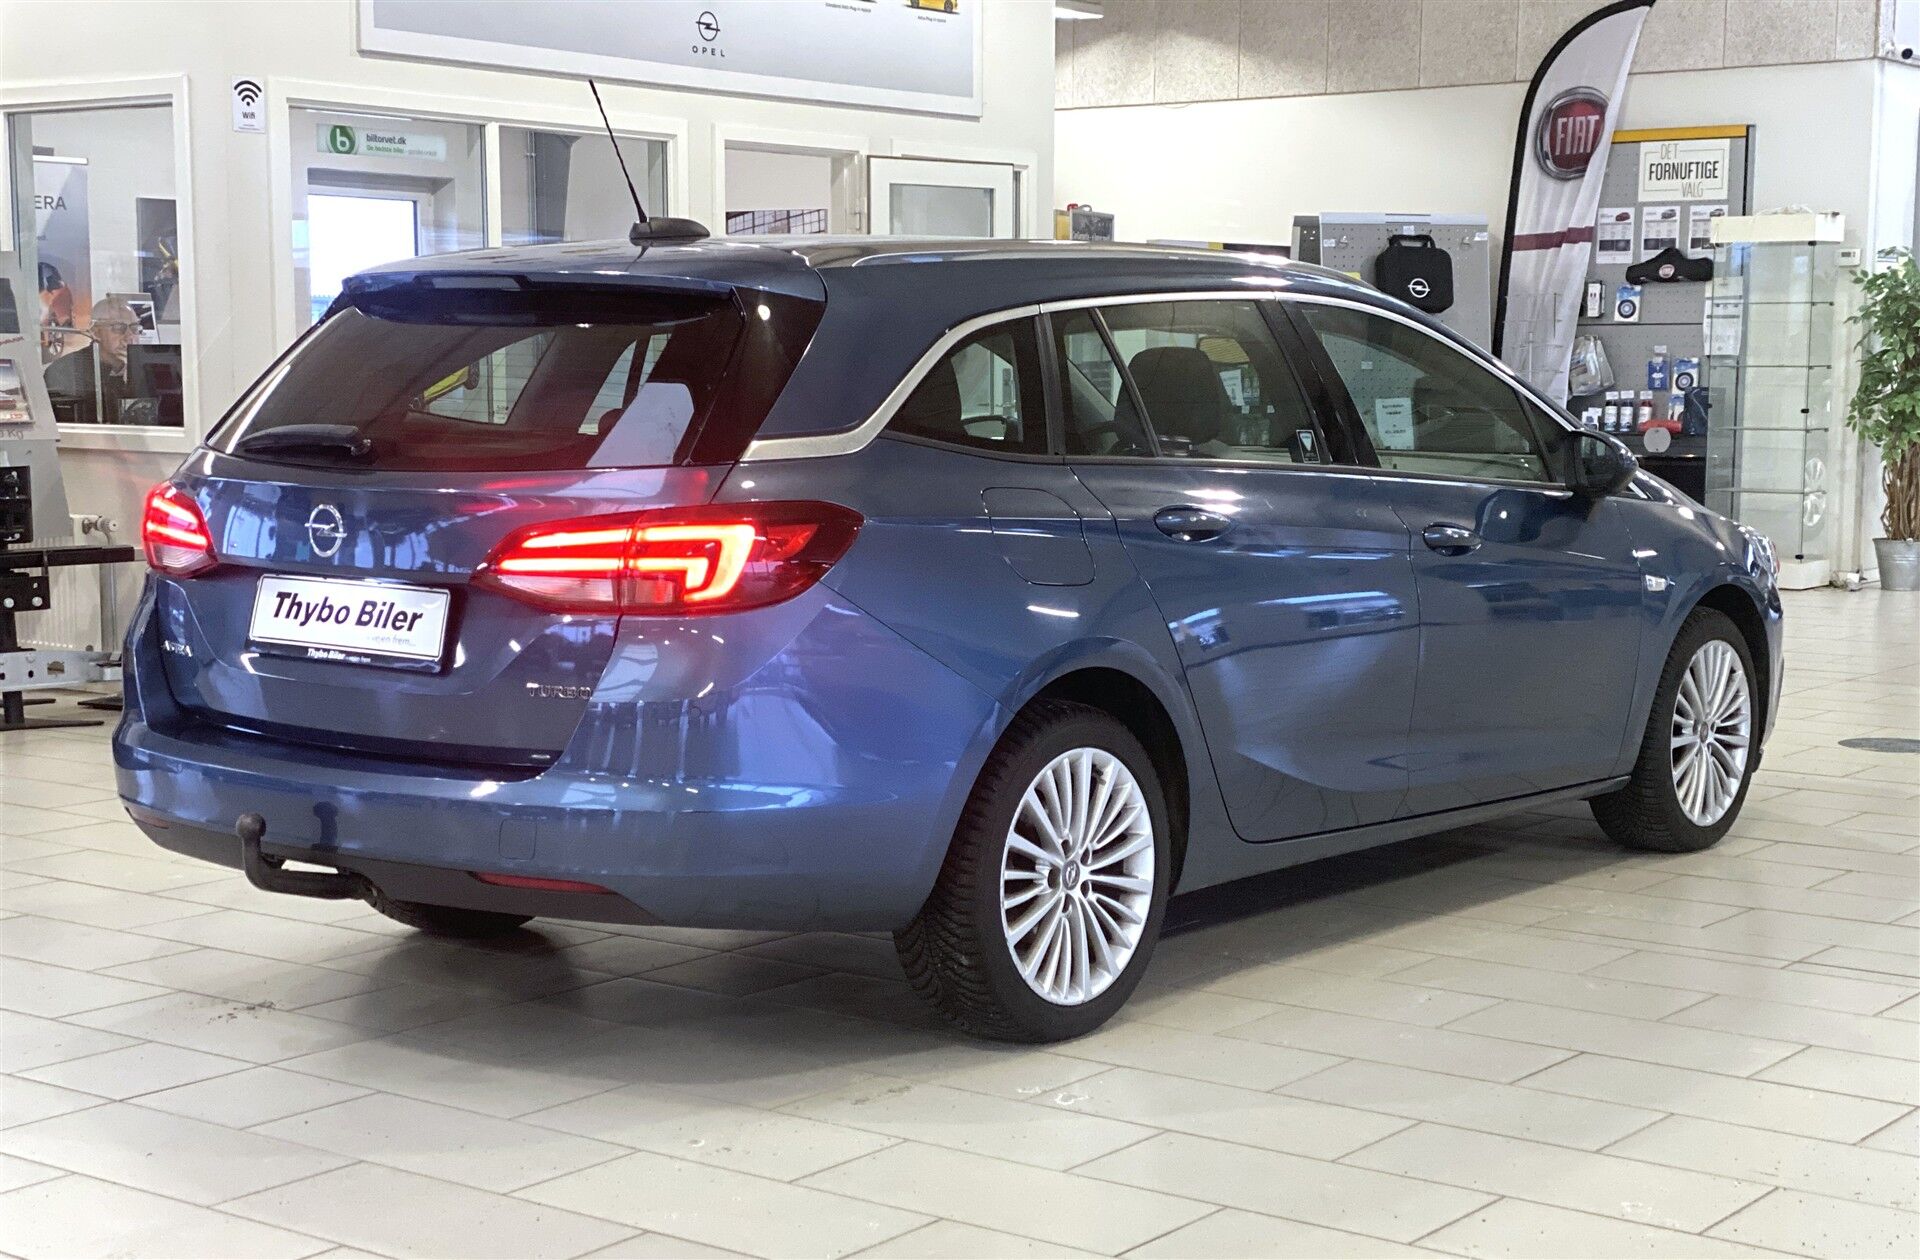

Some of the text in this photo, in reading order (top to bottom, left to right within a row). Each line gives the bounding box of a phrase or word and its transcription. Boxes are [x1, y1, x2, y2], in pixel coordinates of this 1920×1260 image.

[692, 45, 725, 57] OPEL
[366, 133, 407, 146] biltorvet.dk
[1555, 115, 1599, 156] FIAT
[1660, 143, 1680, 160] DET
[1649, 160, 1719, 180] FORNUFTIGE
[1681, 181, 1704, 198] VALG
[273, 591, 424, 632] Thybo Biler
[526, 682, 591, 700] TURBO
